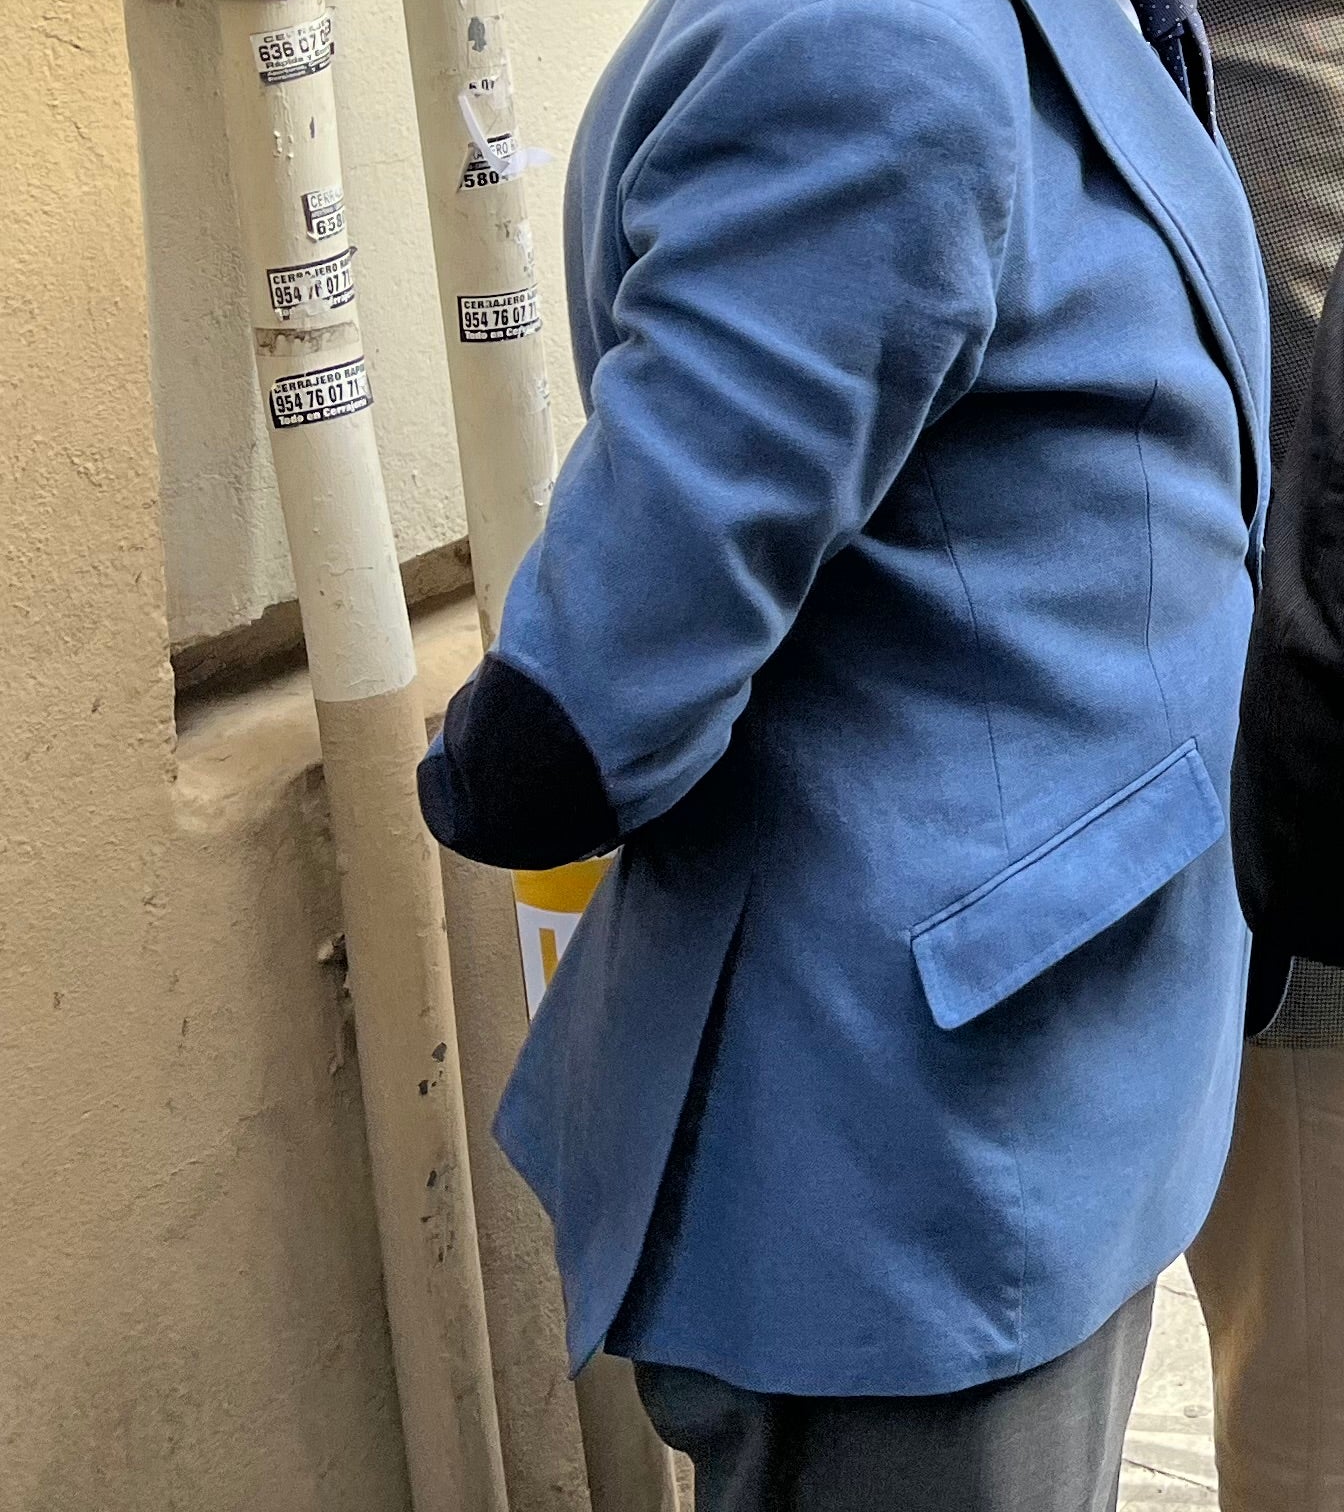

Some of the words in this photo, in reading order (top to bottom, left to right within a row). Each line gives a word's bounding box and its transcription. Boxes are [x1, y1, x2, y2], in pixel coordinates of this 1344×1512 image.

[258, 41, 294, 62] 636
[275, 287, 302, 305] 954
[326, 275, 339, 294] 07
[464, 312, 488, 328] 954
[492, 308, 509, 327] 76
[513, 306, 526, 324] 07
[273, 371, 341, 394] CERRAJERO
[275, 392, 303, 414] 954
[306, 388, 325, 408] 76
[328, 383, 343, 403] 07
[278, 414, 304, 426] Todo
[306, 410, 321, 421] en
